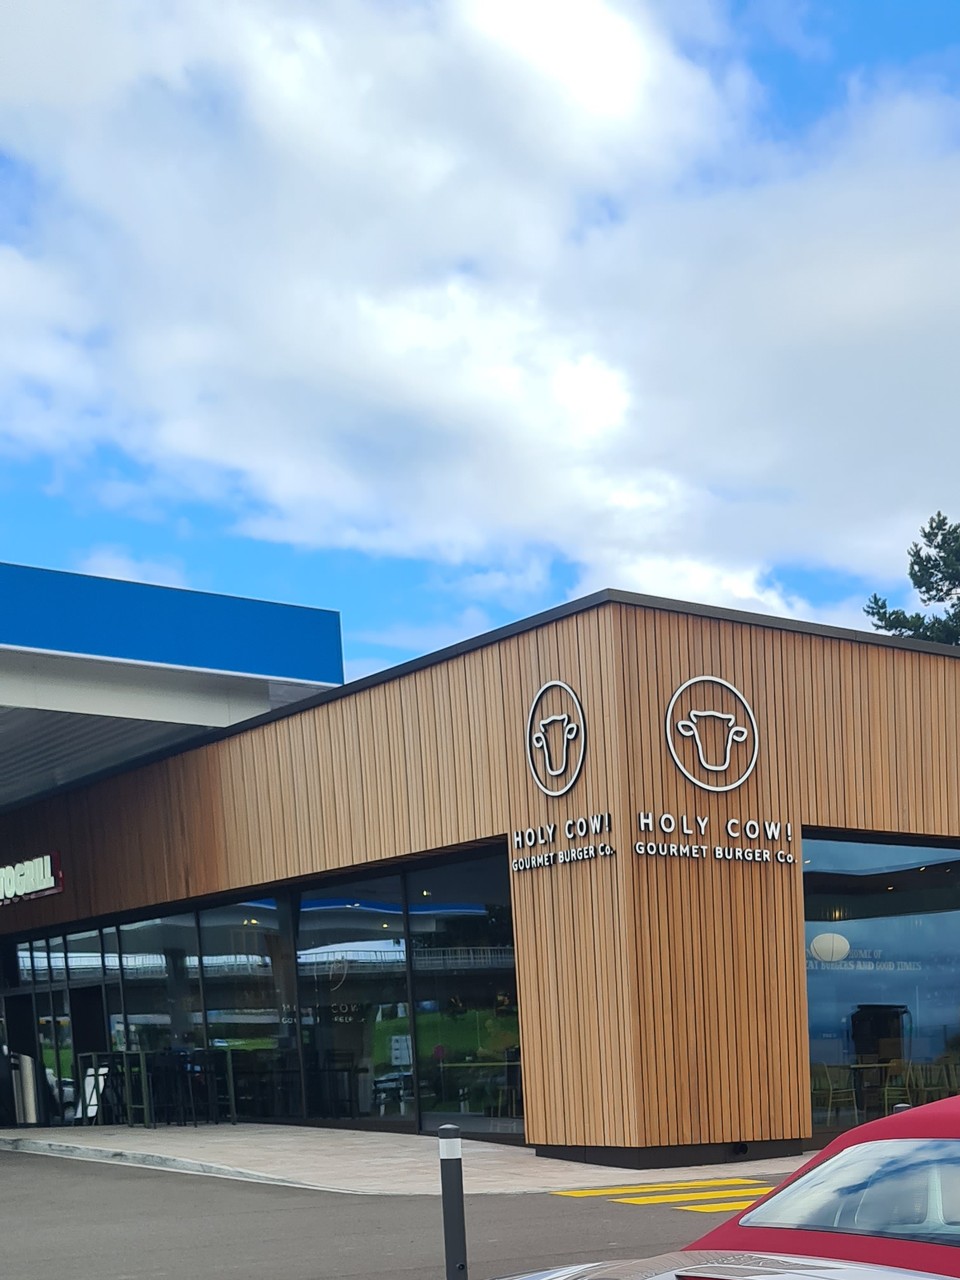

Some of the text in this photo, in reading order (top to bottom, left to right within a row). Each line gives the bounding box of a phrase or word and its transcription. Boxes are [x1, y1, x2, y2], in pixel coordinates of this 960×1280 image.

[513, 812, 612, 850] HOLY COW!
[639, 811, 793, 843] HOLY COW!
[511, 852, 556, 872] GOURMET
[558, 846, 596, 863] BURGER
[635, 842, 798, 865] GOURMET BURGER Co.
